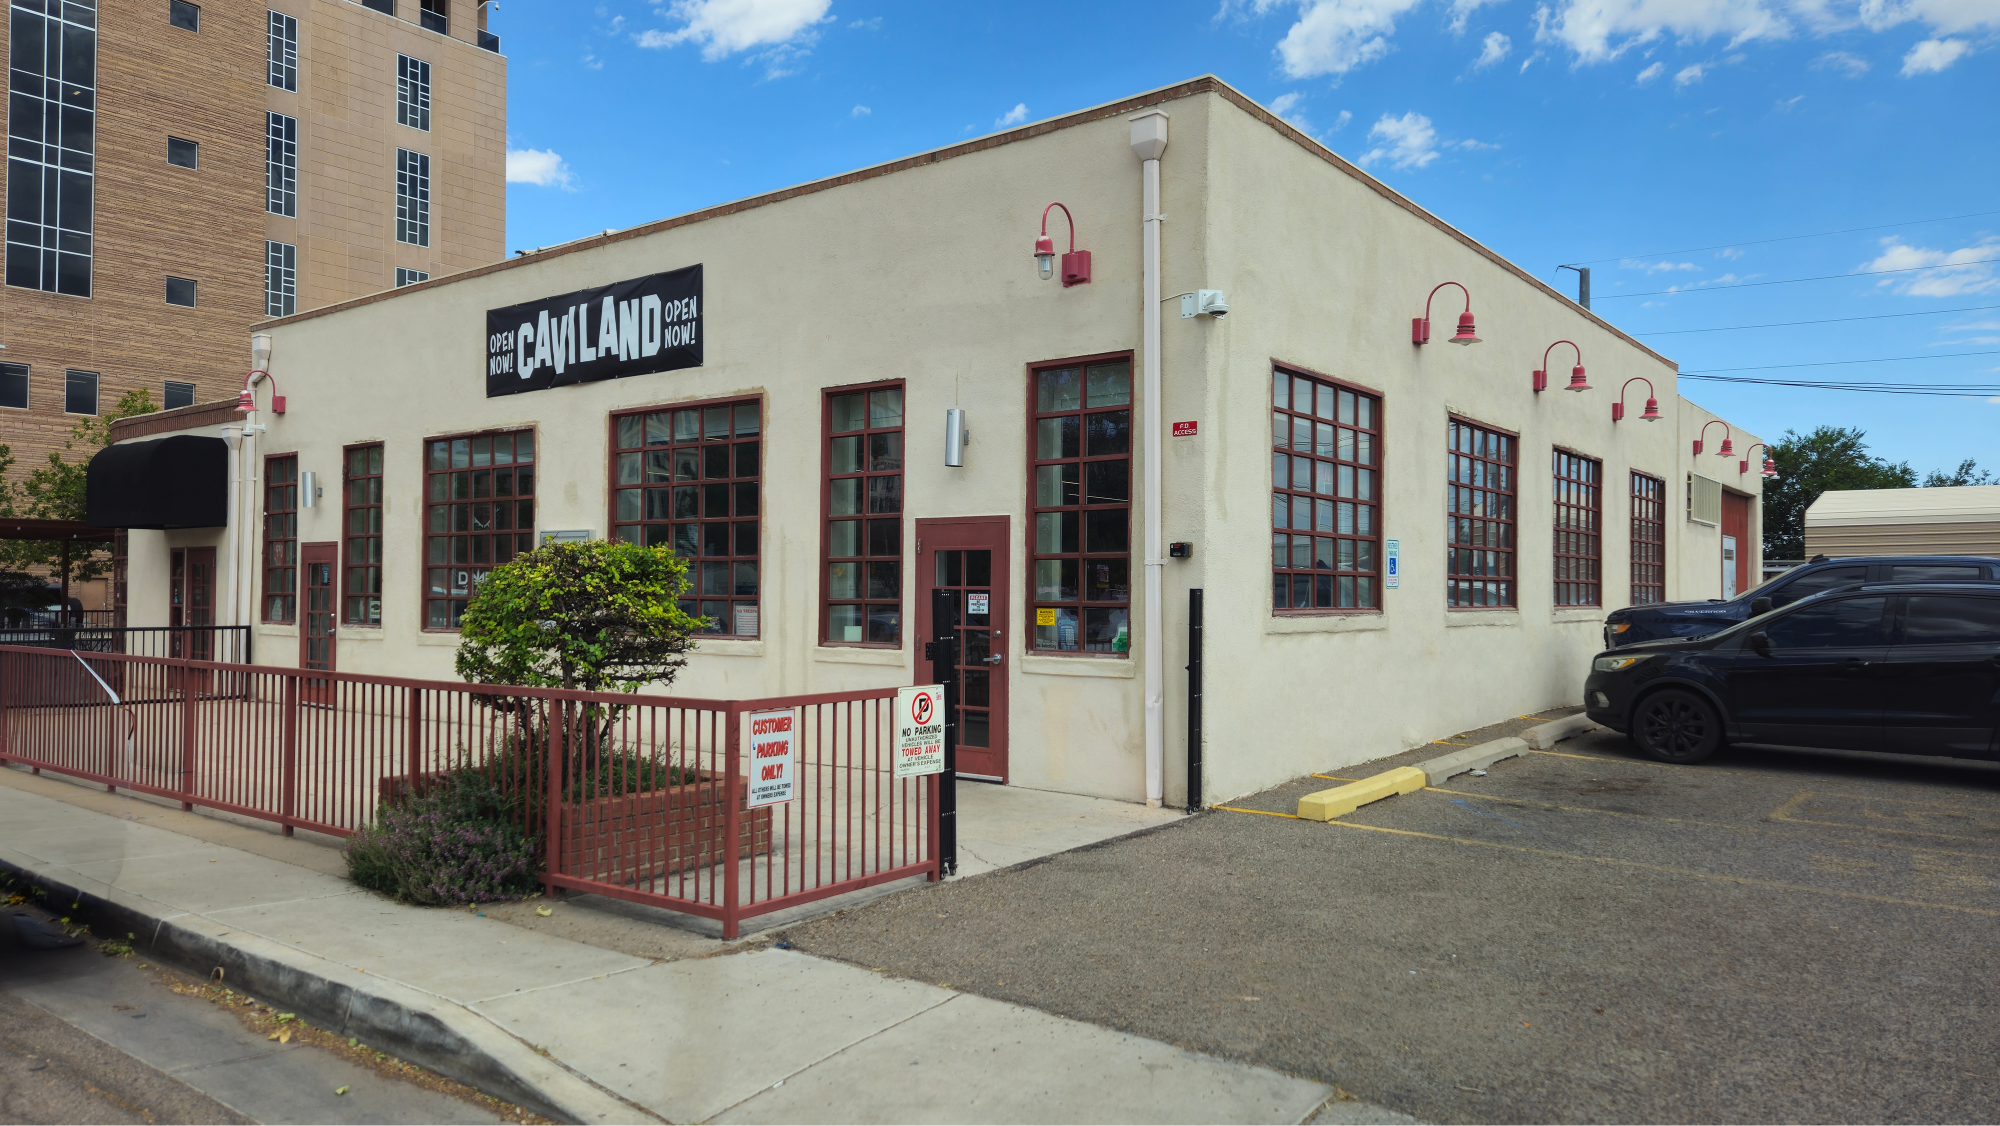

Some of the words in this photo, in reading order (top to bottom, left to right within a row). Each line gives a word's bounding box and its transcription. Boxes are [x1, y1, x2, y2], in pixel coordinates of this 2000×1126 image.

[665, 296, 697, 323] OPEN
[490, 330, 514, 354] OPEN
[517, 293, 662, 380] CAVILAND
[664, 321, 696, 348] NOW!
[490, 352, 513, 376] NOW!
[752, 716, 792, 735] CUSTOMER
[902, 728, 911, 737] NO
[915, 724, 941, 736] PARKING
[756, 740, 789, 759] PARKING
[901, 747, 922, 757] TOWED
[925, 744, 941, 754] AWAY
[761, 763, 783, 781] ONLY!
